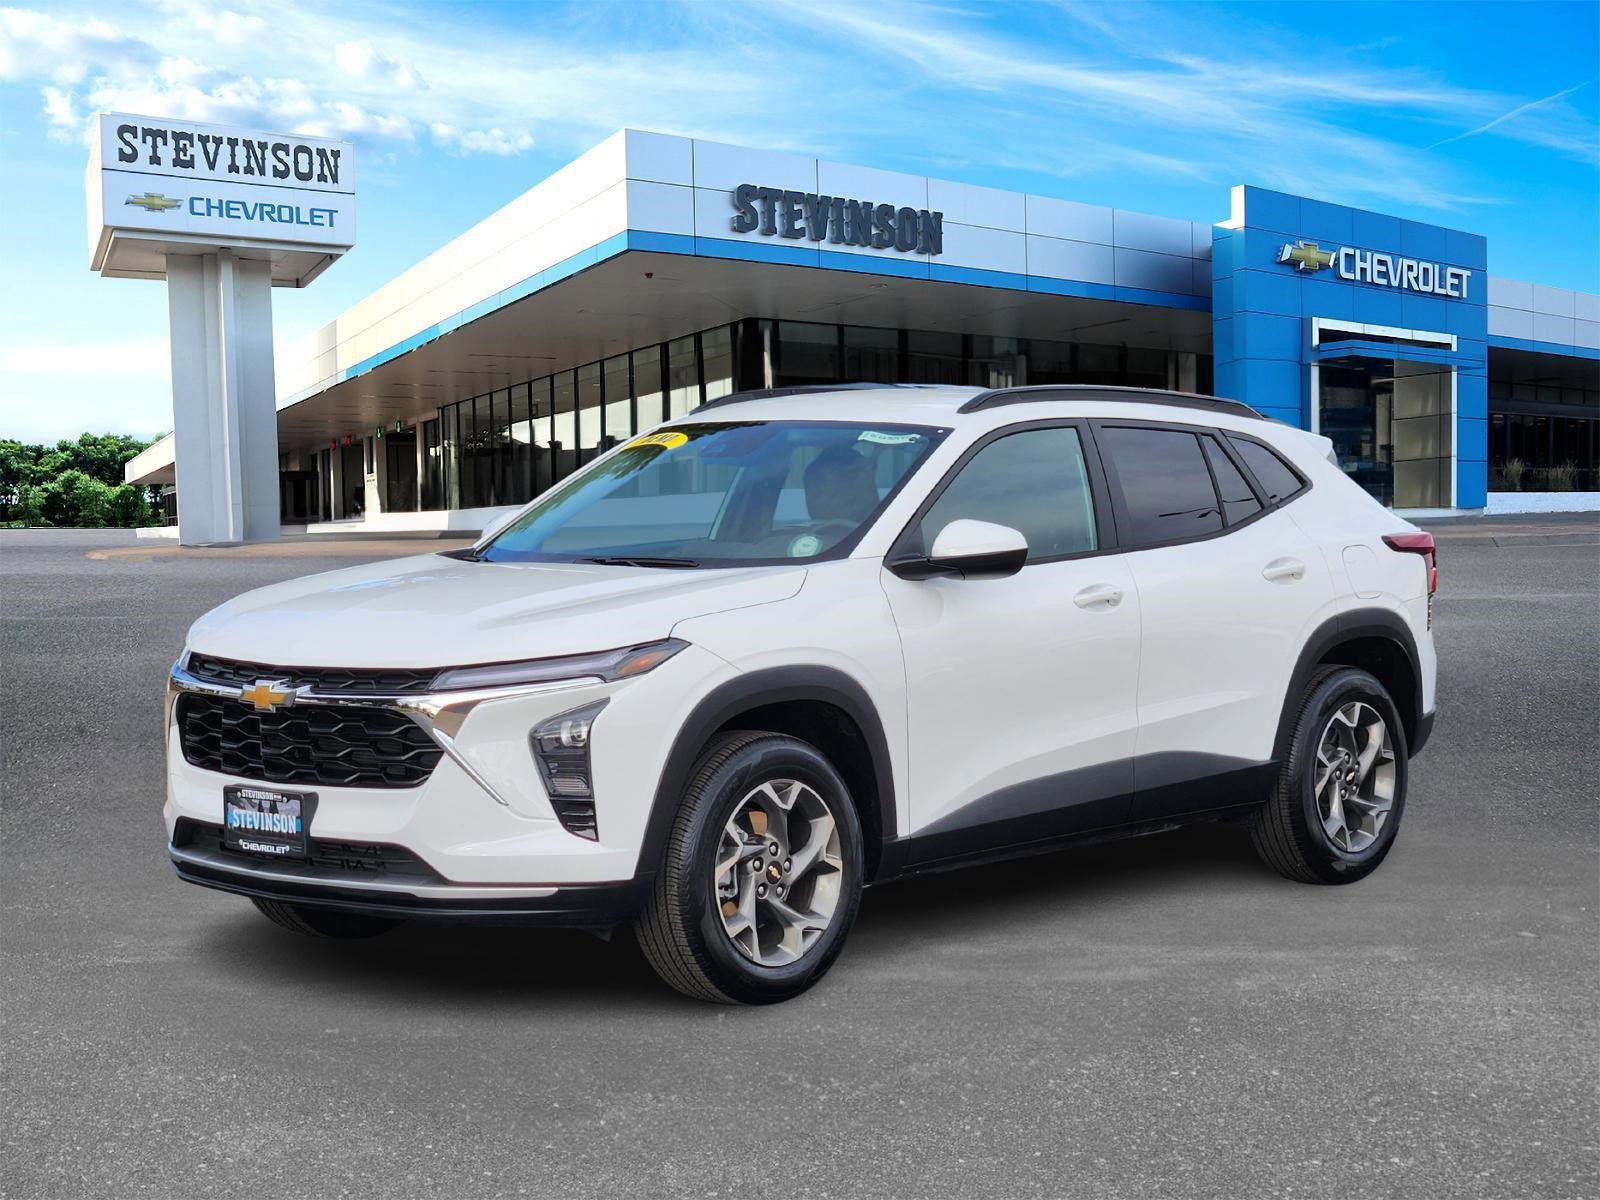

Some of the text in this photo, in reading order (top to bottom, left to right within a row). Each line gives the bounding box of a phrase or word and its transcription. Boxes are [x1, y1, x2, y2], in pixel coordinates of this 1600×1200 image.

[117, 124, 341, 184] STEVINSON
[188, 196, 339, 228] CHEVROLET
[732, 183, 943, 255] STEVINSON
[1339, 246, 1471, 298] CHEVROLET
[241, 789, 274, 801] STEVINSON
[232, 808, 297, 834] STEVINSON
[242, 842, 287, 854] CHEVROLET
